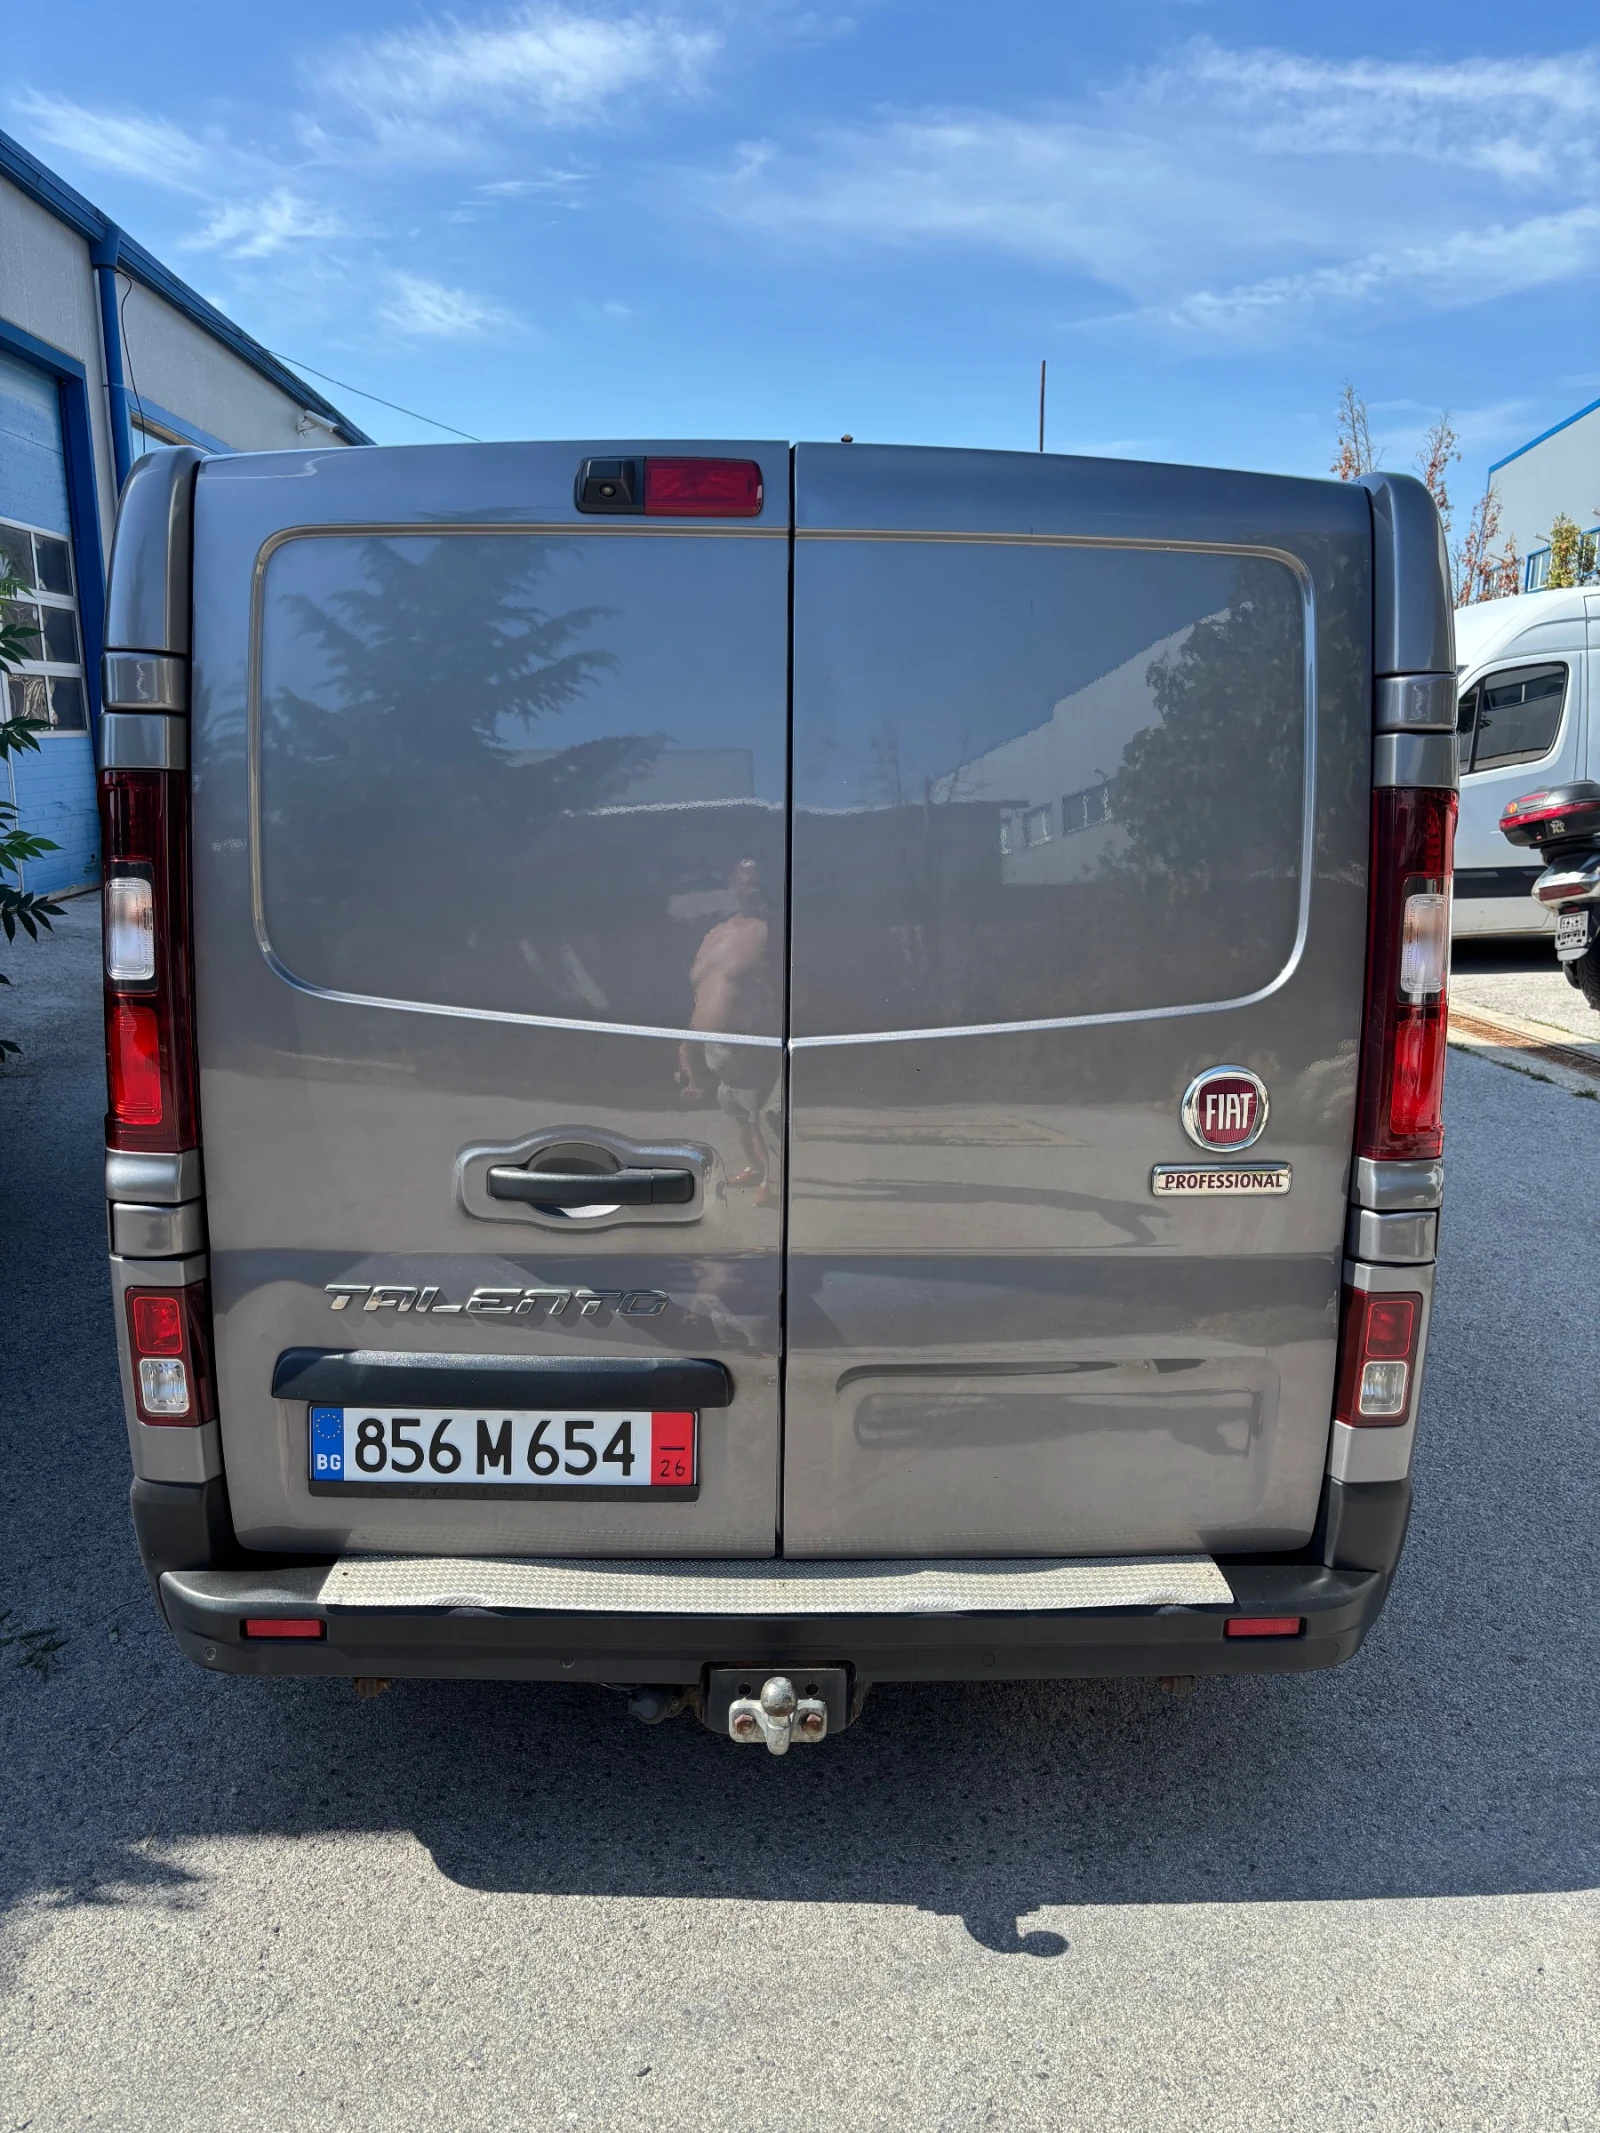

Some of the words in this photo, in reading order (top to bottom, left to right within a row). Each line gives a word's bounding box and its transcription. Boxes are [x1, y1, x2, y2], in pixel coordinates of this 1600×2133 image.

[1206, 1093, 1253, 1130] FIAT
[1165, 1174, 1283, 1189] PROFESSIONAL
[325, 1284, 668, 1316] TALENTO
[354, 1418, 462, 1474] 856
[476, 1420, 512, 1475] M
[527, 1420, 636, 1477] 654
[316, 1453, 342, 1471] BG
[660, 1460, 686, 1478] 26
